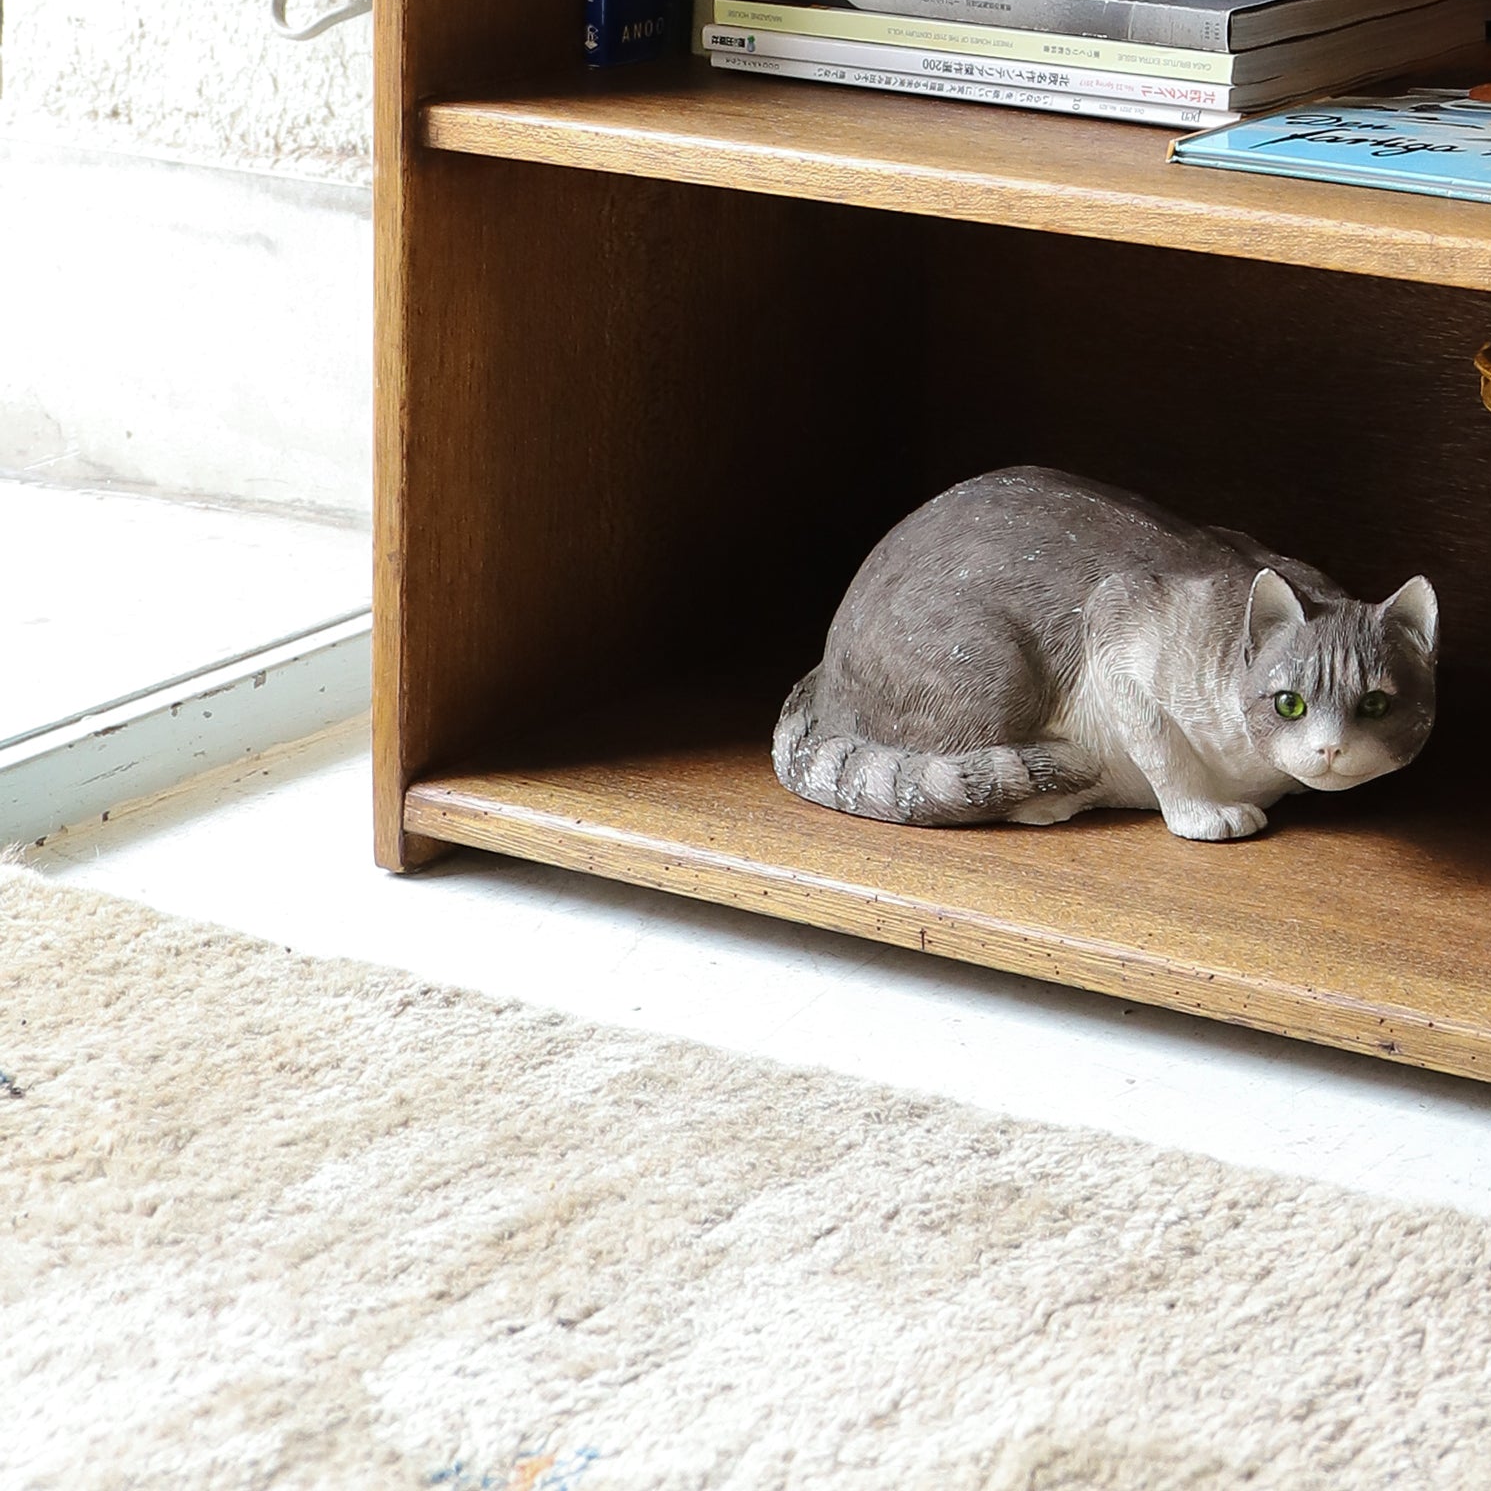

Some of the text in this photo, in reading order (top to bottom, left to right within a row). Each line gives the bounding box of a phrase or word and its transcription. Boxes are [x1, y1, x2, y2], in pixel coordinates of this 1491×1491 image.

[727, 9, 782, 23] MAGAZINE HOUSE
[1117, 53, 1212, 72] CASA BRUTUS EXTRA ISSUE
[1095, 79, 1114, 91] Spring
[1141, 84, 1216, 105] 北欧スタイル
[1181, 109, 1202, 124] pen
[1286, 114, 1397, 132] Den
